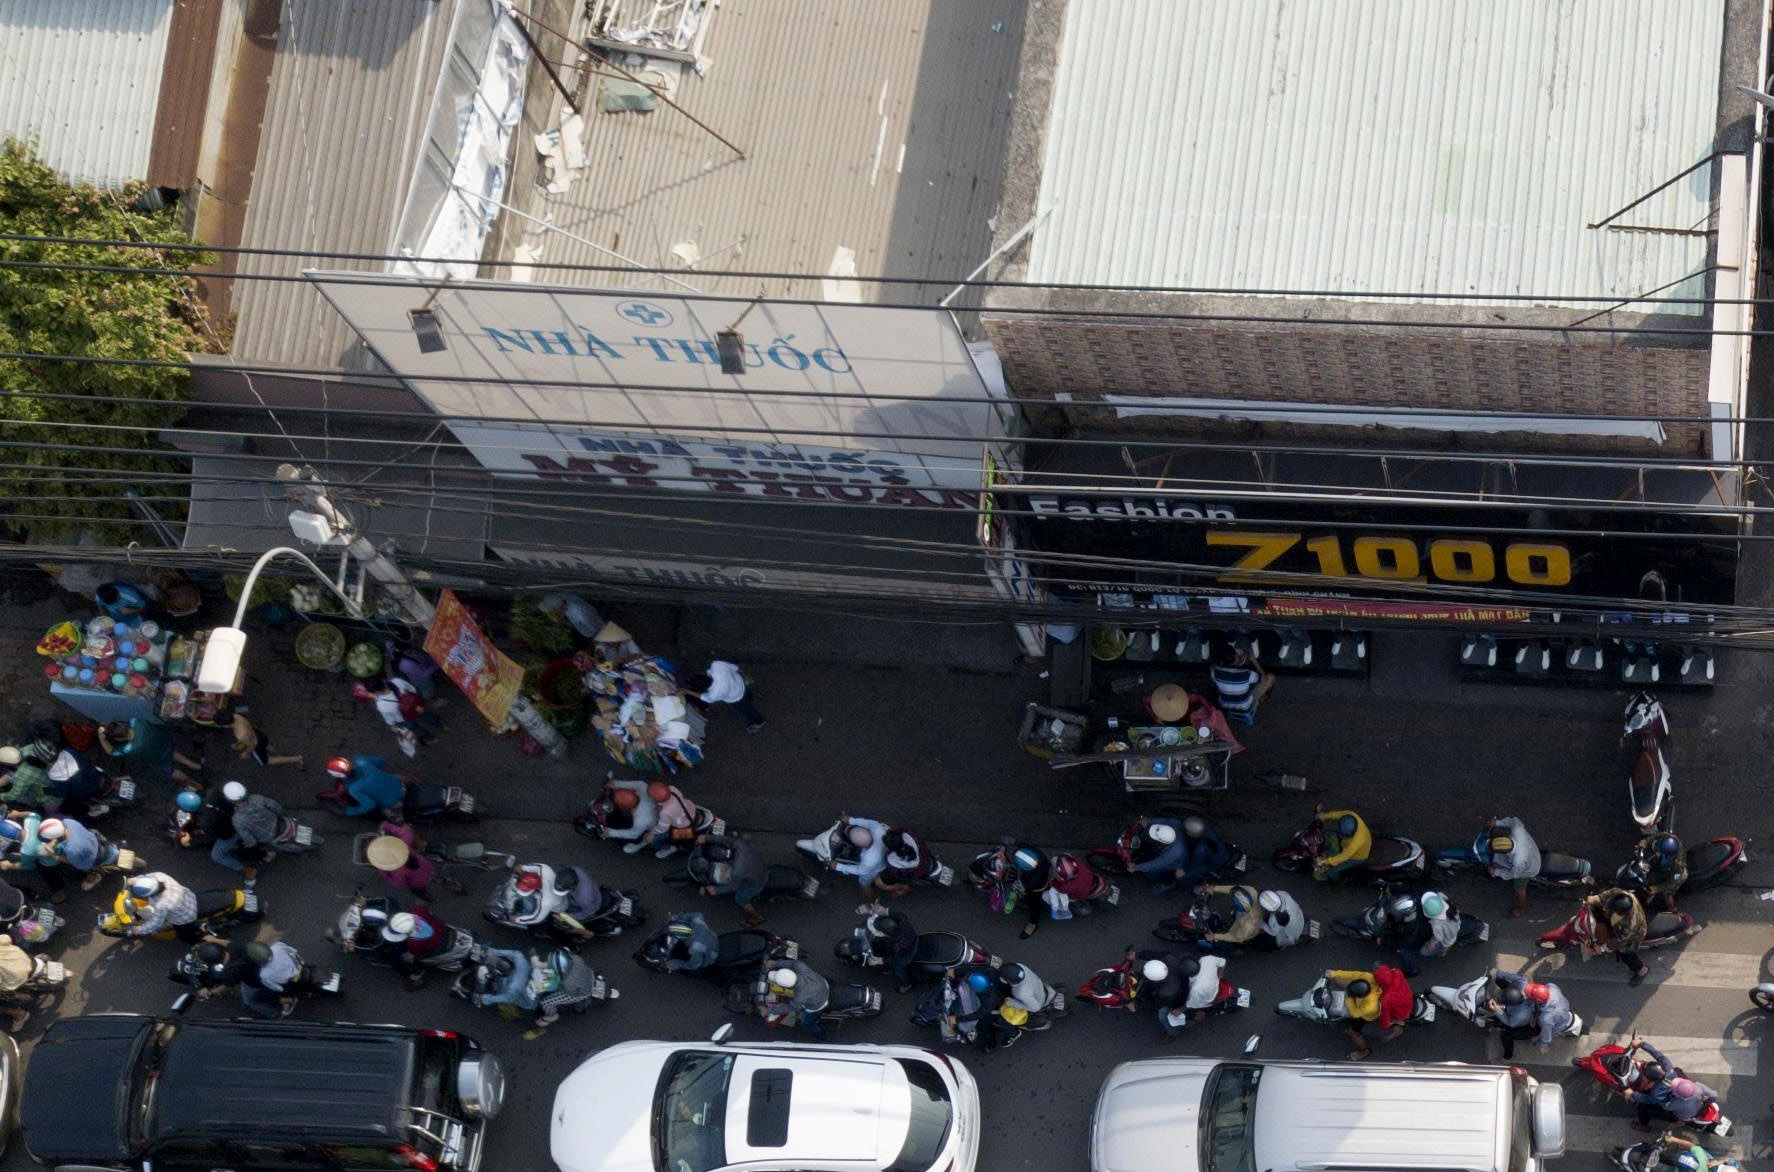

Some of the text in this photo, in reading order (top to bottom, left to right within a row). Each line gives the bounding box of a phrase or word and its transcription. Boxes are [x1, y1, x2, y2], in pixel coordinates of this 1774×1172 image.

[480, 324, 626, 360] NHÀ
[577, 437, 698, 461] NHÀ
[1030, 497, 1237, 525] Fashion
[1206, 531, 1571, 586] Z1000
